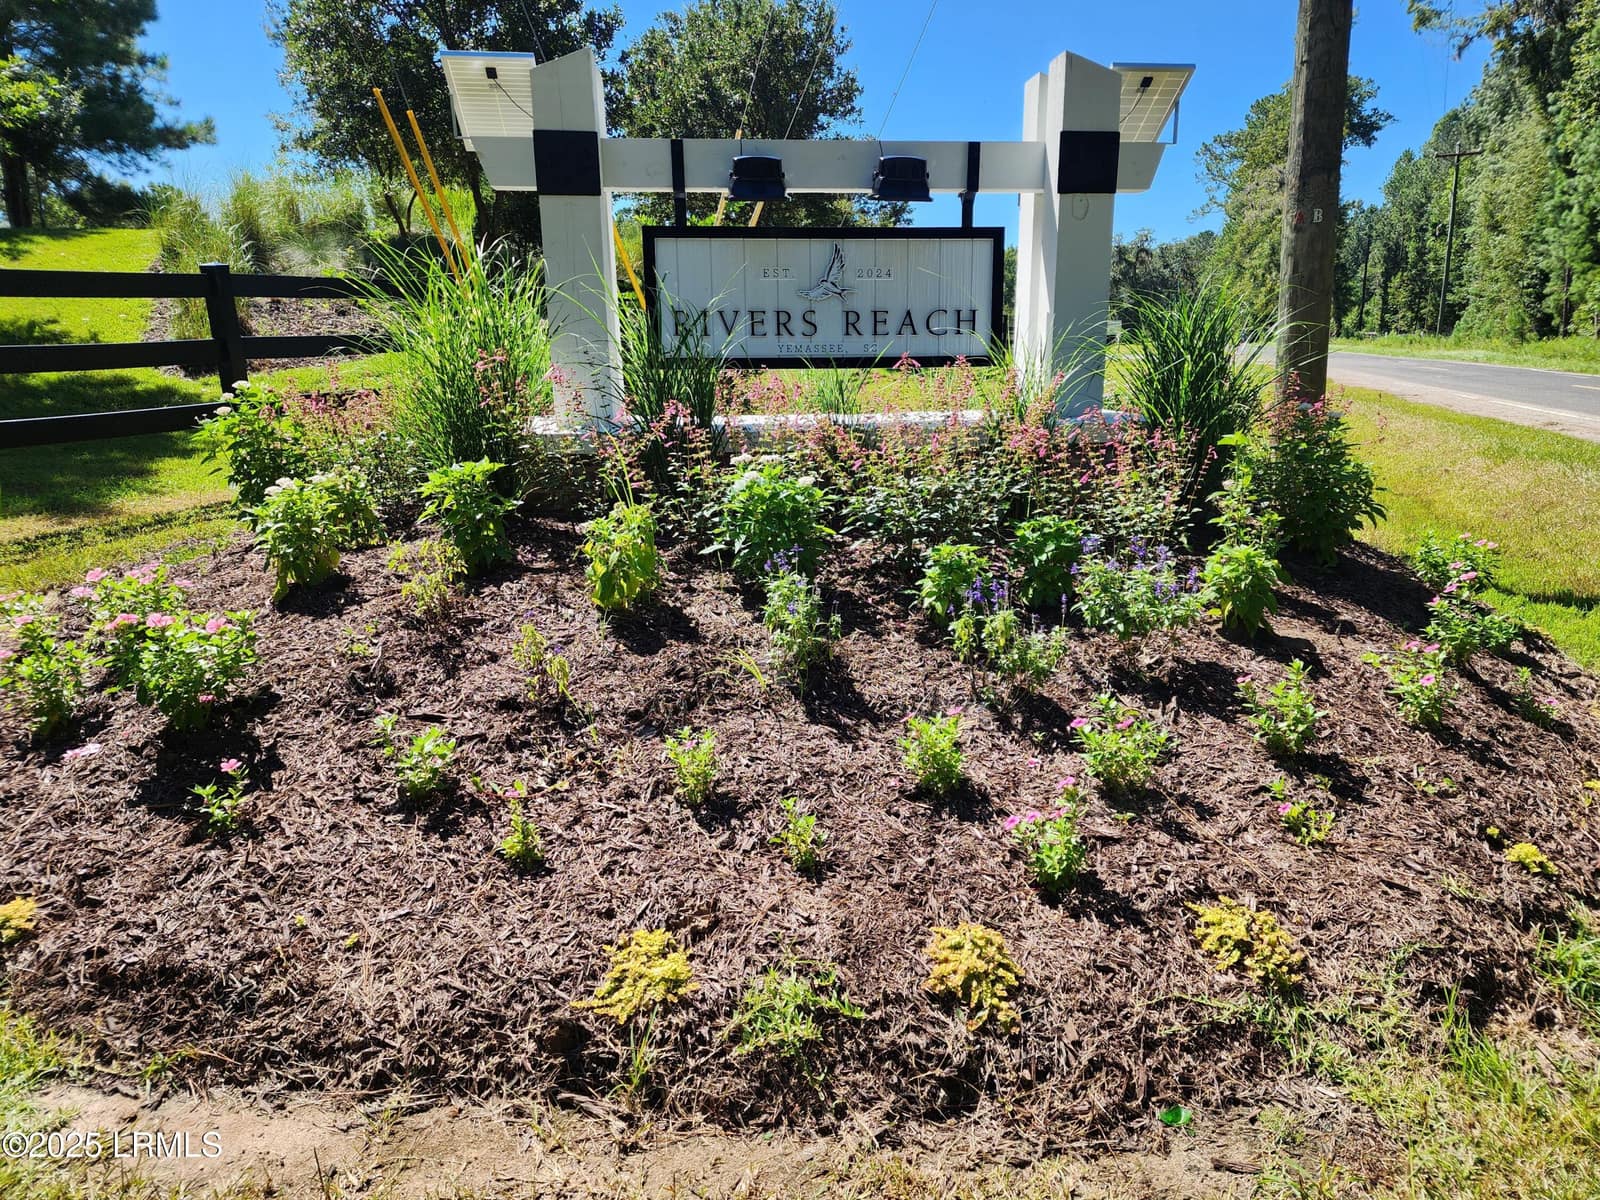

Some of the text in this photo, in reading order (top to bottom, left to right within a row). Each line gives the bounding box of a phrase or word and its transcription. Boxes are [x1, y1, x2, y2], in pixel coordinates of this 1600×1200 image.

[1312, 208, 1323, 223] B
[762, 268, 892, 278] EST. 2024
[673, 309, 978, 337] RIVERS REACH
[863, 343, 878, 353] SC
